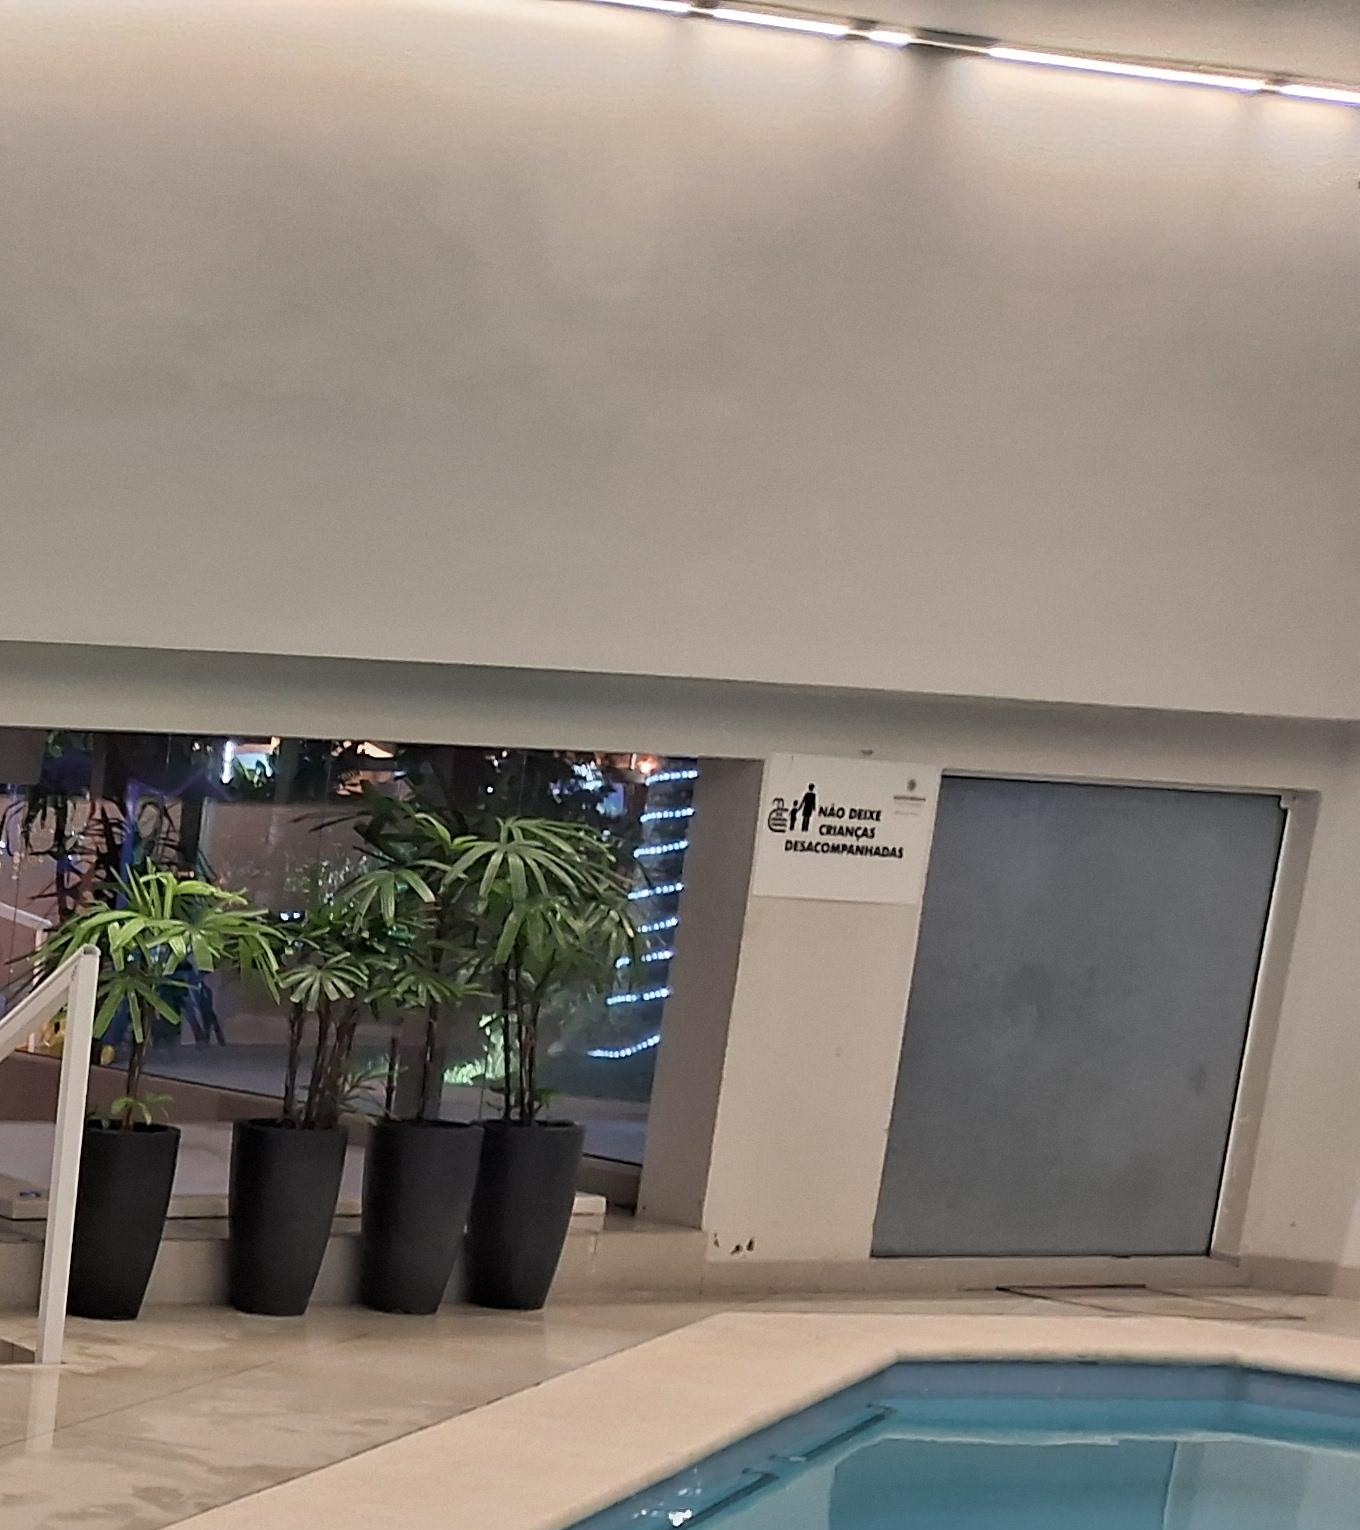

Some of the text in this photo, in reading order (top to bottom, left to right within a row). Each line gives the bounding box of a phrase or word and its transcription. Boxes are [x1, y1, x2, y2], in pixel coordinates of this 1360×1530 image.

[818, 804, 845, 818] NÃO
[848, 807, 882, 822] DEIXE
[819, 824, 876, 841] CRIANÇAS
[784, 839, 904, 859] DESACOMPANHADAS
